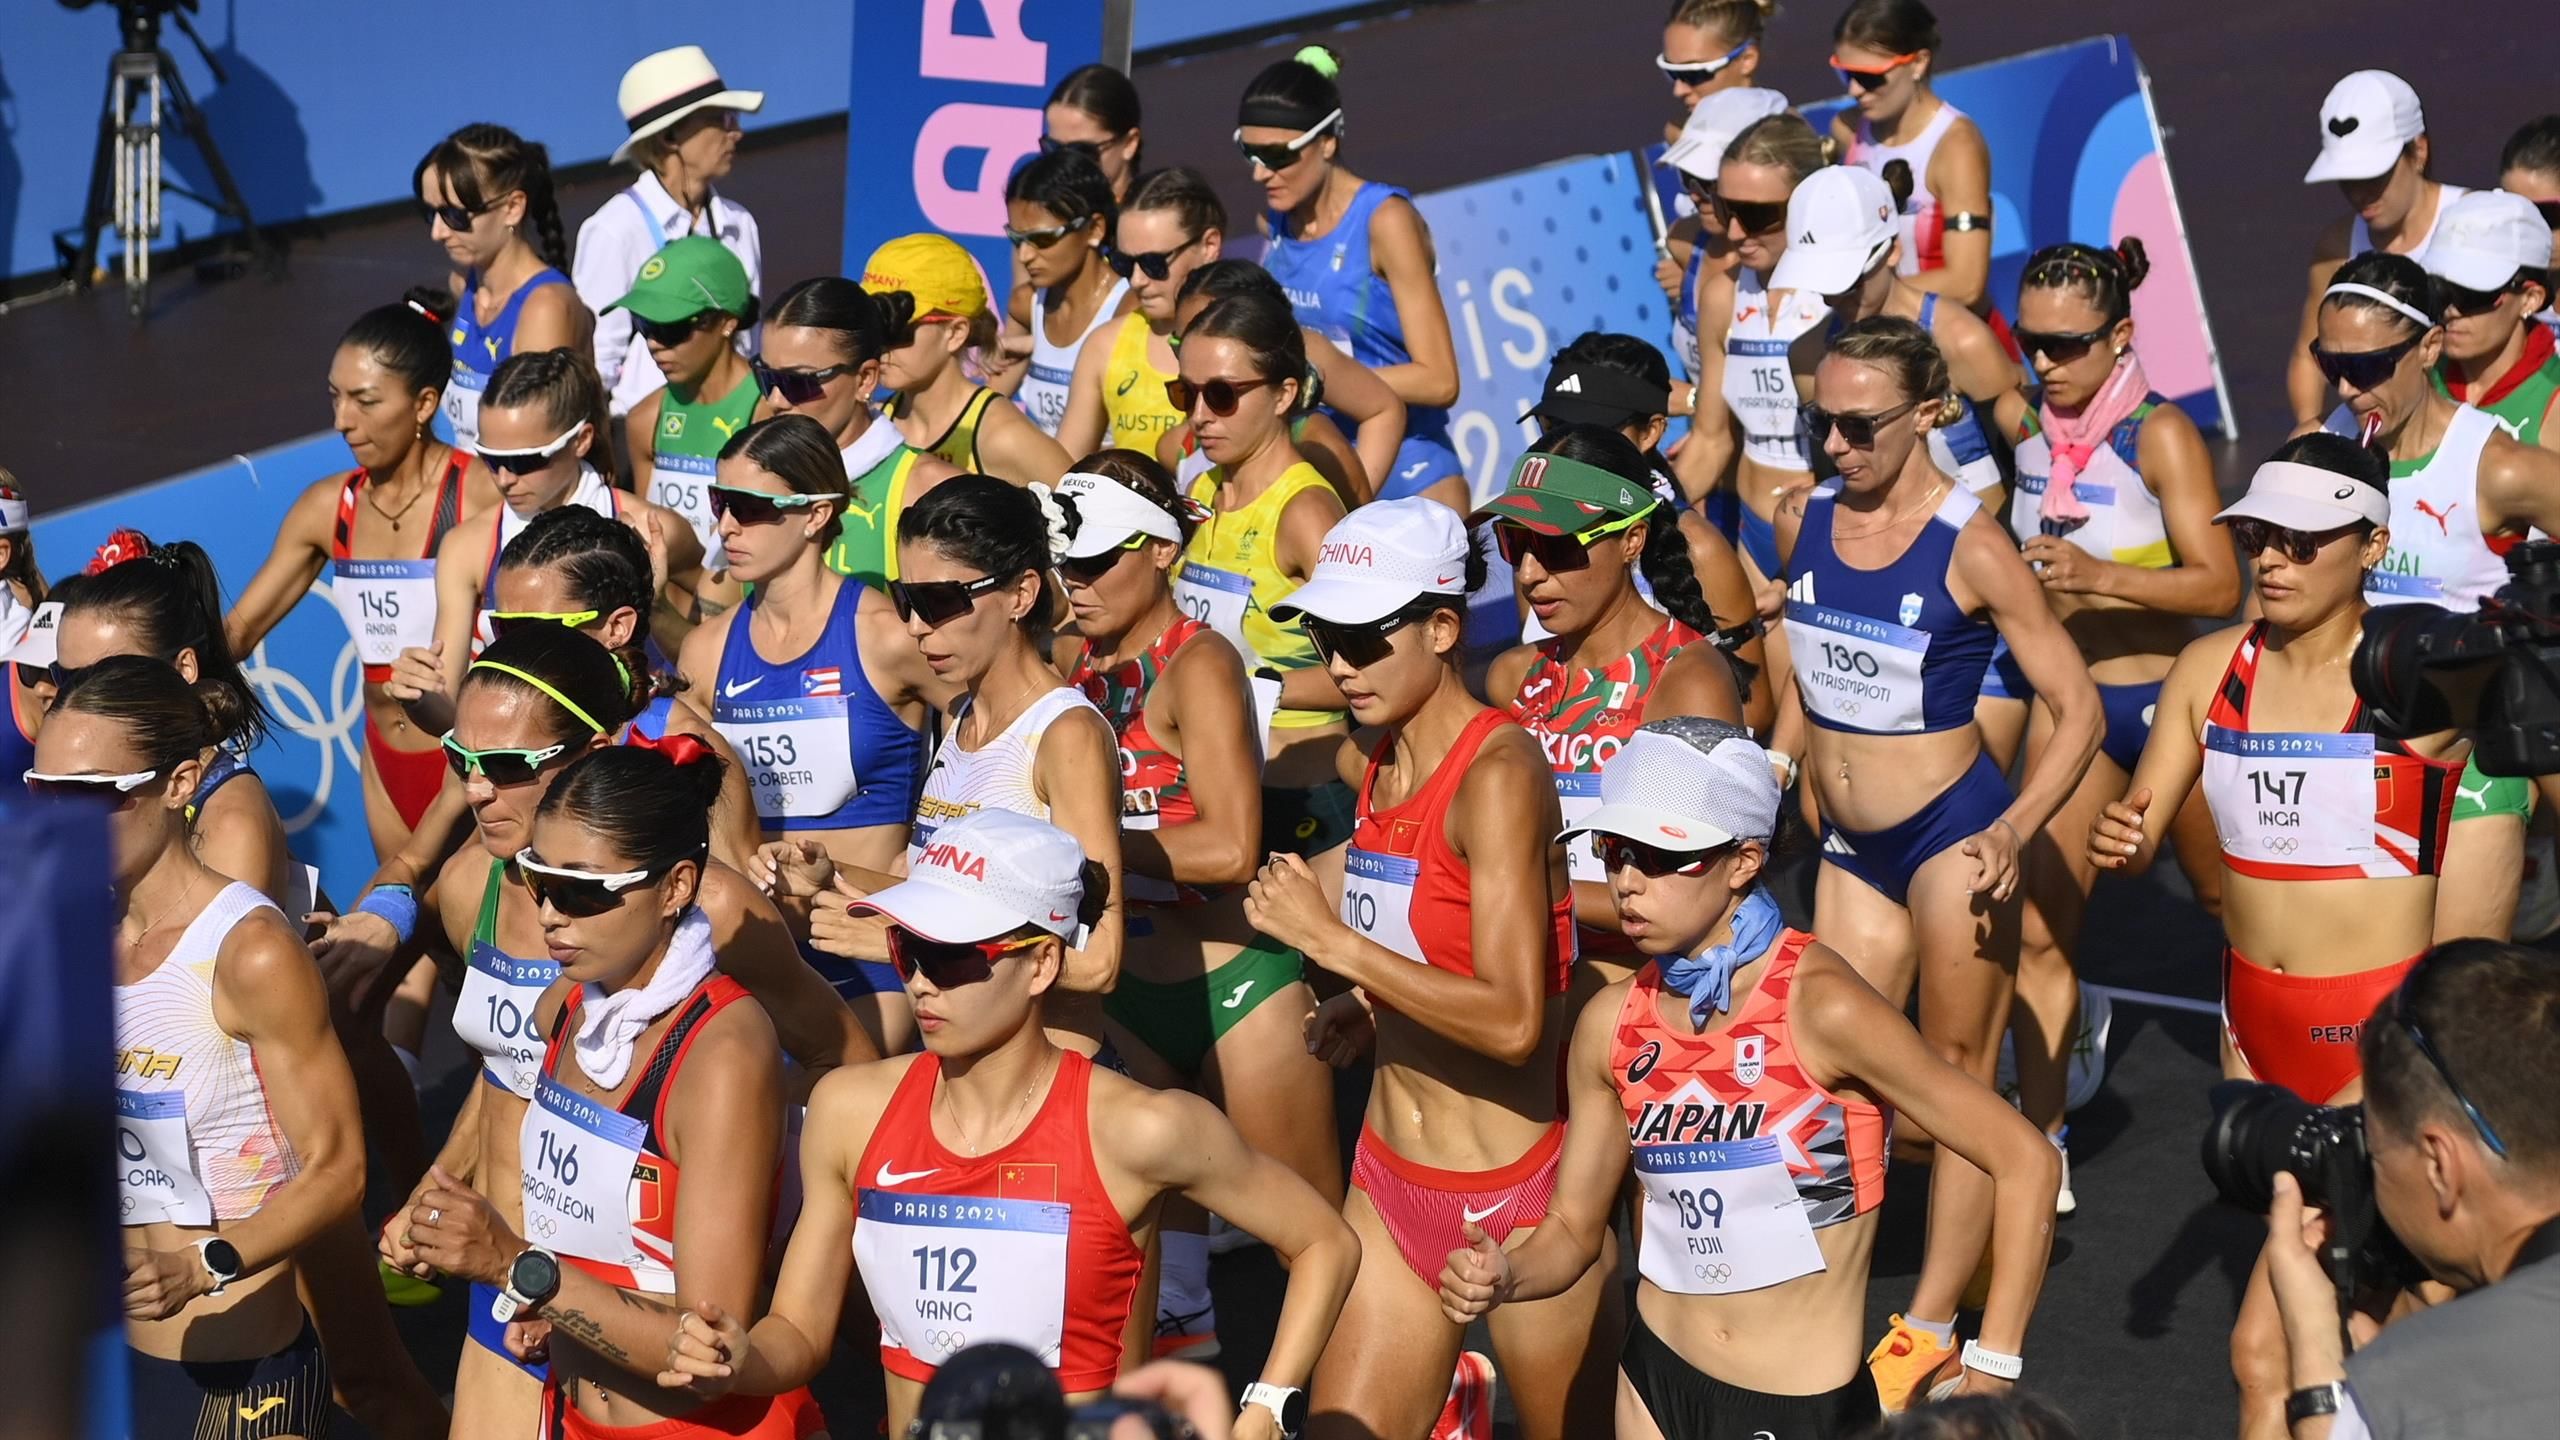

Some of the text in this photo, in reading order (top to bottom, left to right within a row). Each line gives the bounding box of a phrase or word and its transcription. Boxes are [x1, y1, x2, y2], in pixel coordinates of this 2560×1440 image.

[1752, 368, 1784, 393] 115
[1037, 391, 1065, 417] 135
[1116, 413, 1190, 432] AUSTR
[658, 482, 698, 511] 105
[1317, 543, 1372, 568] CHINA
[349, 564, 408, 575] PARIS 2024
[358, 590, 400, 618] 145
[366, 622, 397, 637] ANDIA
[1817, 612, 1888, 639] PARIS 2024
[1821, 641, 1880, 679] 130
[1811, 669, 1891, 703] NTRISMPIOTI
[733, 705, 804, 718] PARIS 2024
[744, 734, 797, 768] 153
[1528, 722, 1623, 768] XICO
[2240, 739, 2324, 751] ARIS 2024
[758, 770, 814, 788] ORBETA
[2247, 769, 2307, 806] 147
[2258, 811, 2300, 827] INGA
[1360, 858, 1384, 874] 2024
[1346, 888, 1376, 932] 110
[490, 956, 513, 977] PARIS
[542, 1087, 601, 1128] PARIS 2024
[1629, 1101, 1767, 1144] JAPAN
[537, 1128, 579, 1187] 146
[1647, 1150, 1727, 1166] PARIS 2024
[556, 1191, 594, 1225] LEON
[894, 1201, 1007, 1222] PARIS 2024
[1668, 1187, 1724, 1230] 139
[1687, 1236, 1724, 1255] FUJII
[912, 1244, 978, 1293] 112
[915, 1298, 973, 1323] YANG
